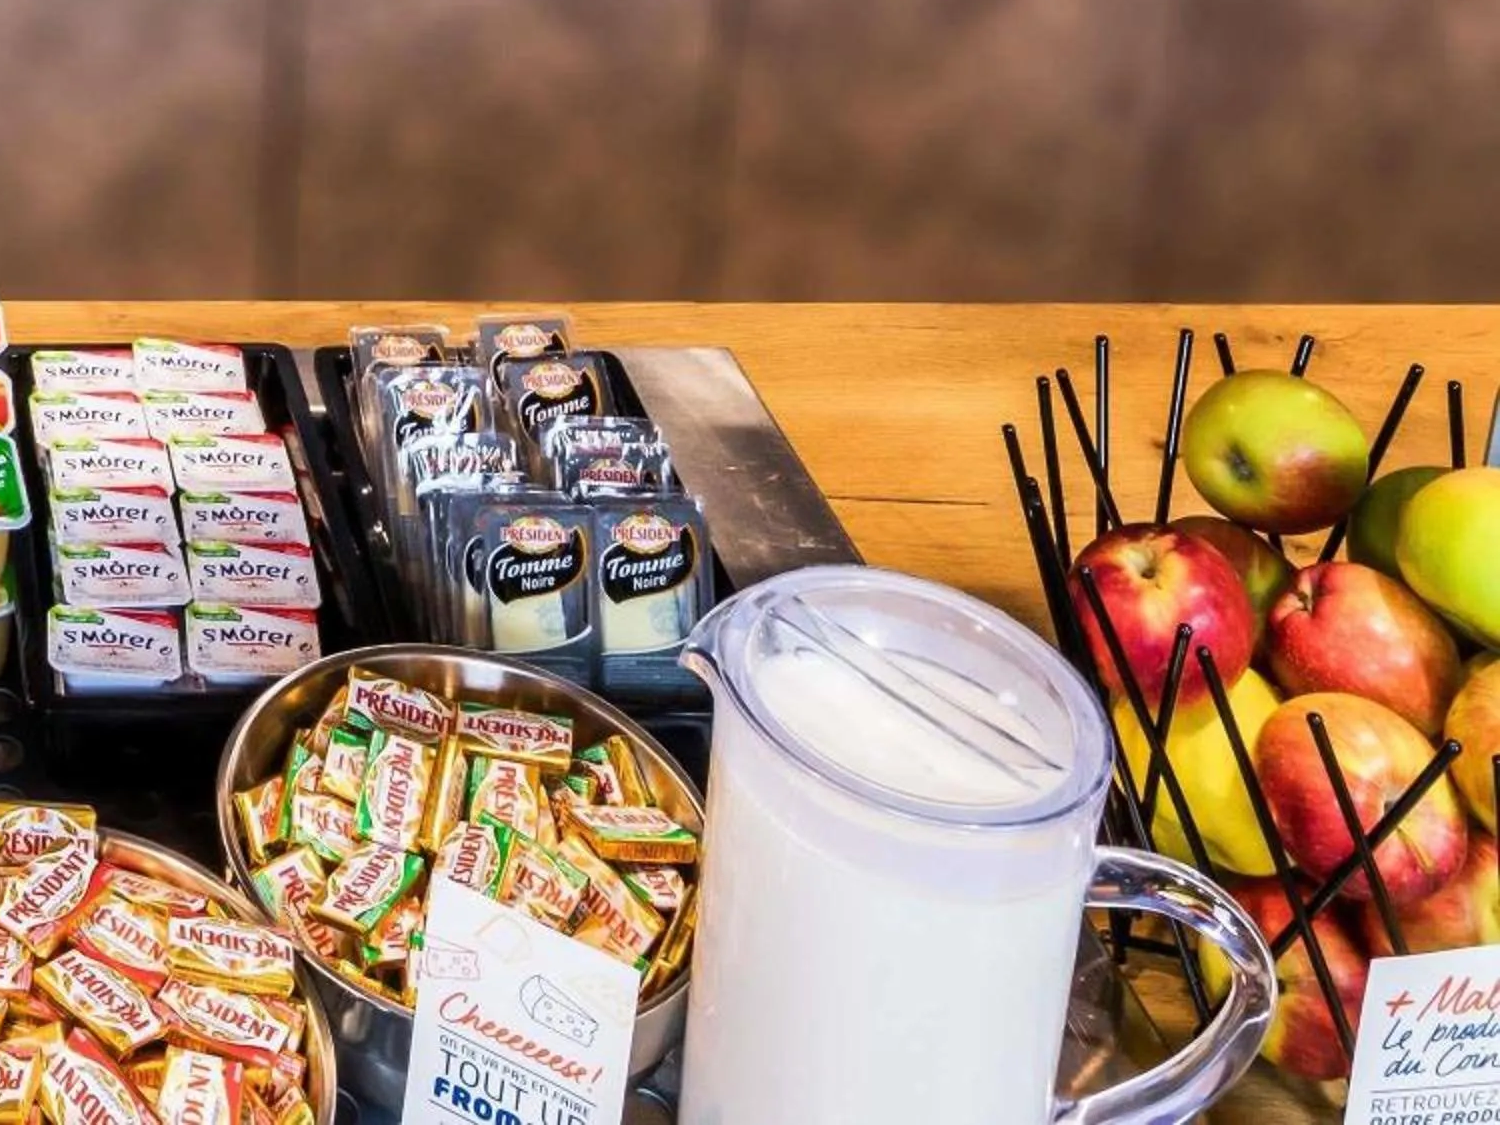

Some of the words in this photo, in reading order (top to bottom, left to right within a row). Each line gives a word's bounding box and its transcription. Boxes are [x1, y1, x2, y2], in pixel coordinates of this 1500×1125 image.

[525, 395, 589, 421] Tomme
[613, 525, 682, 542] PRÉSIDENT
[496, 554, 573, 577] Tomme
[607, 553, 684, 579] Tomme
[521, 575, 555, 591] Noire
[633, 574, 667, 591] Noire
[357, 687, 453, 733] PRÉSIDENT
[449, 824, 485, 889] ÉSIDENT
[6, 849, 88, 925] PRÉSIDENT
[178, 925, 291, 962] PRÉSIDENT
[60, 955, 150, 1032] PRÉSIDENT
[164, 979, 279, 1042] PRÉSIDENT
[1382, 1019, 1414, 1050] Le
[1384, 1049, 1427, 1078] du
[440, 1048, 528, 1112] TOUT
[434, 1077, 523, 1125] FROM
[1371, 1089, 1499, 1114] RETROUVEZ
